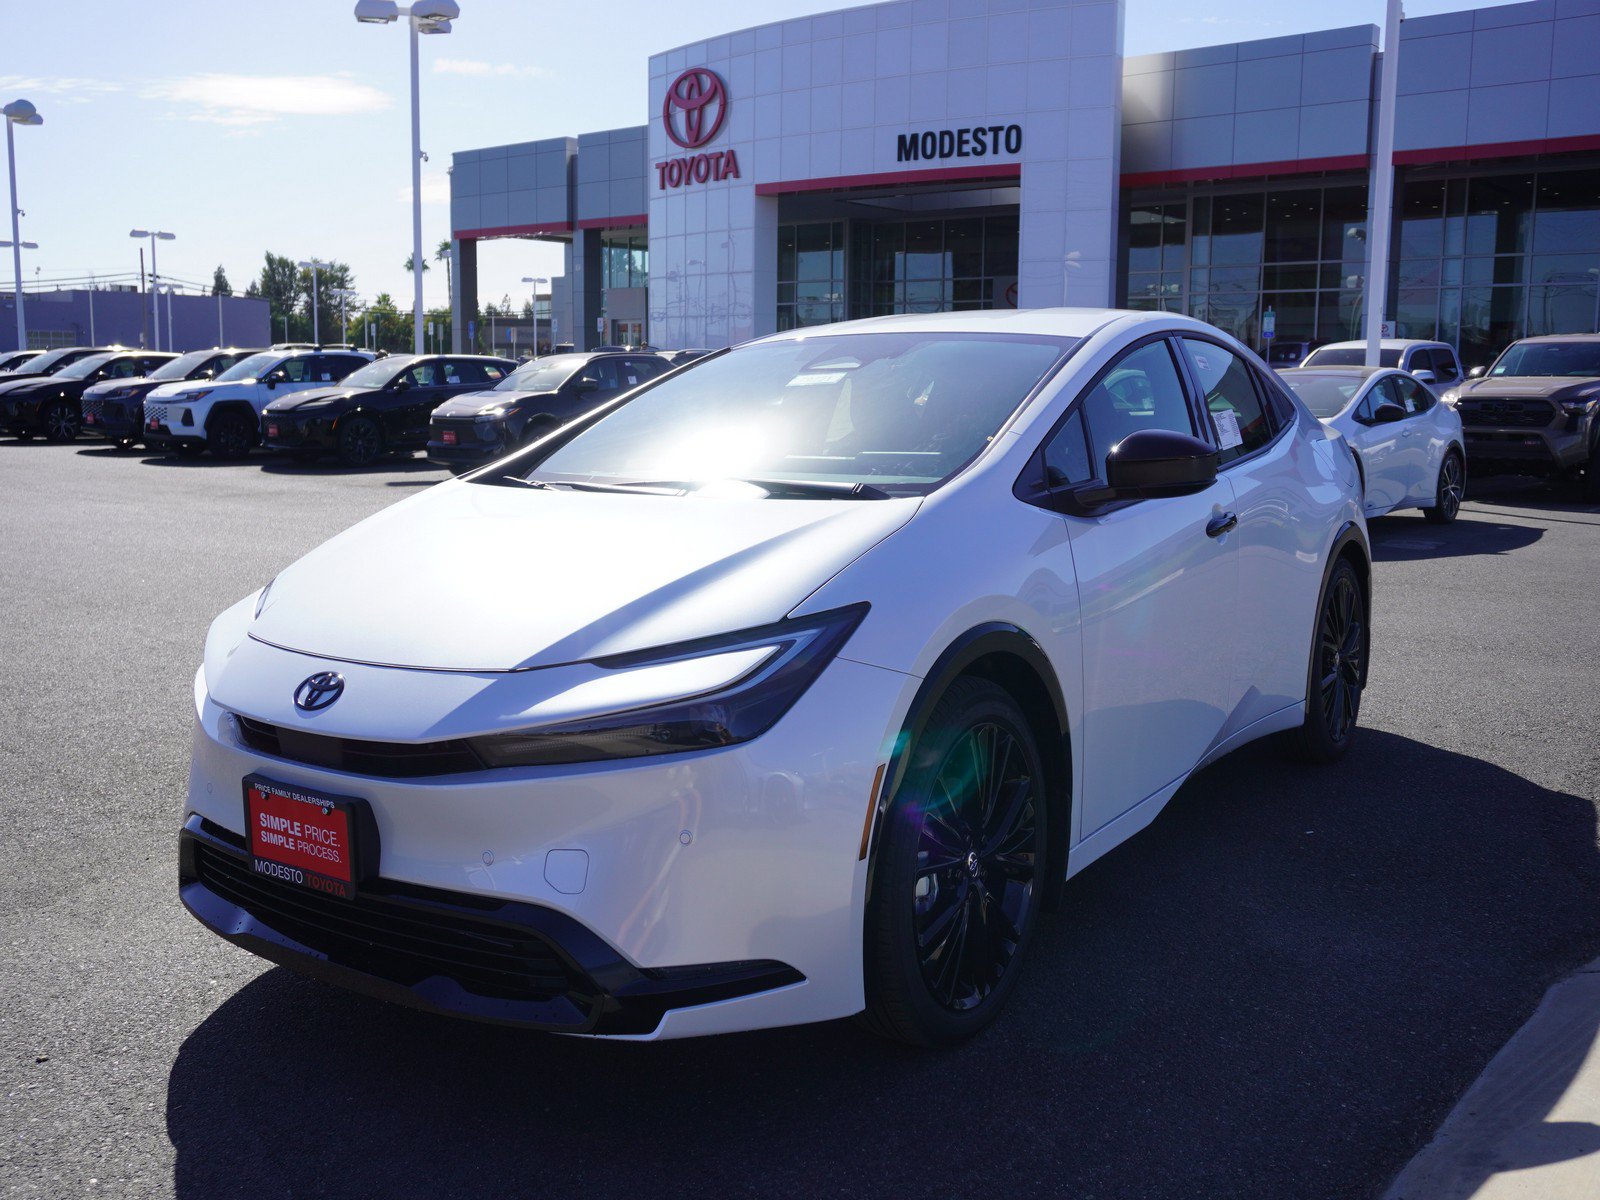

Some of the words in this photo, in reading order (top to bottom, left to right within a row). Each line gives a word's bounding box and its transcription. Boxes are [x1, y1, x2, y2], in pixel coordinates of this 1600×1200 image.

[897, 124, 1023, 162] MODESTO
[655, 149, 741, 190] TOYOTA
[254, 782, 271, 794] PRICE
[271, 787, 292, 799] FAMILY
[292, 792, 335, 809] DEALERSHIPS
[260, 812, 302, 837] SIMPLE
[304, 824, 341, 847] PRICE.
[261, 830, 296, 850] SIMPLE
[297, 840, 342, 863] PROCESS.
[254, 859, 303, 884] MODESTO
[306, 873, 346, 897] TOYOTA
